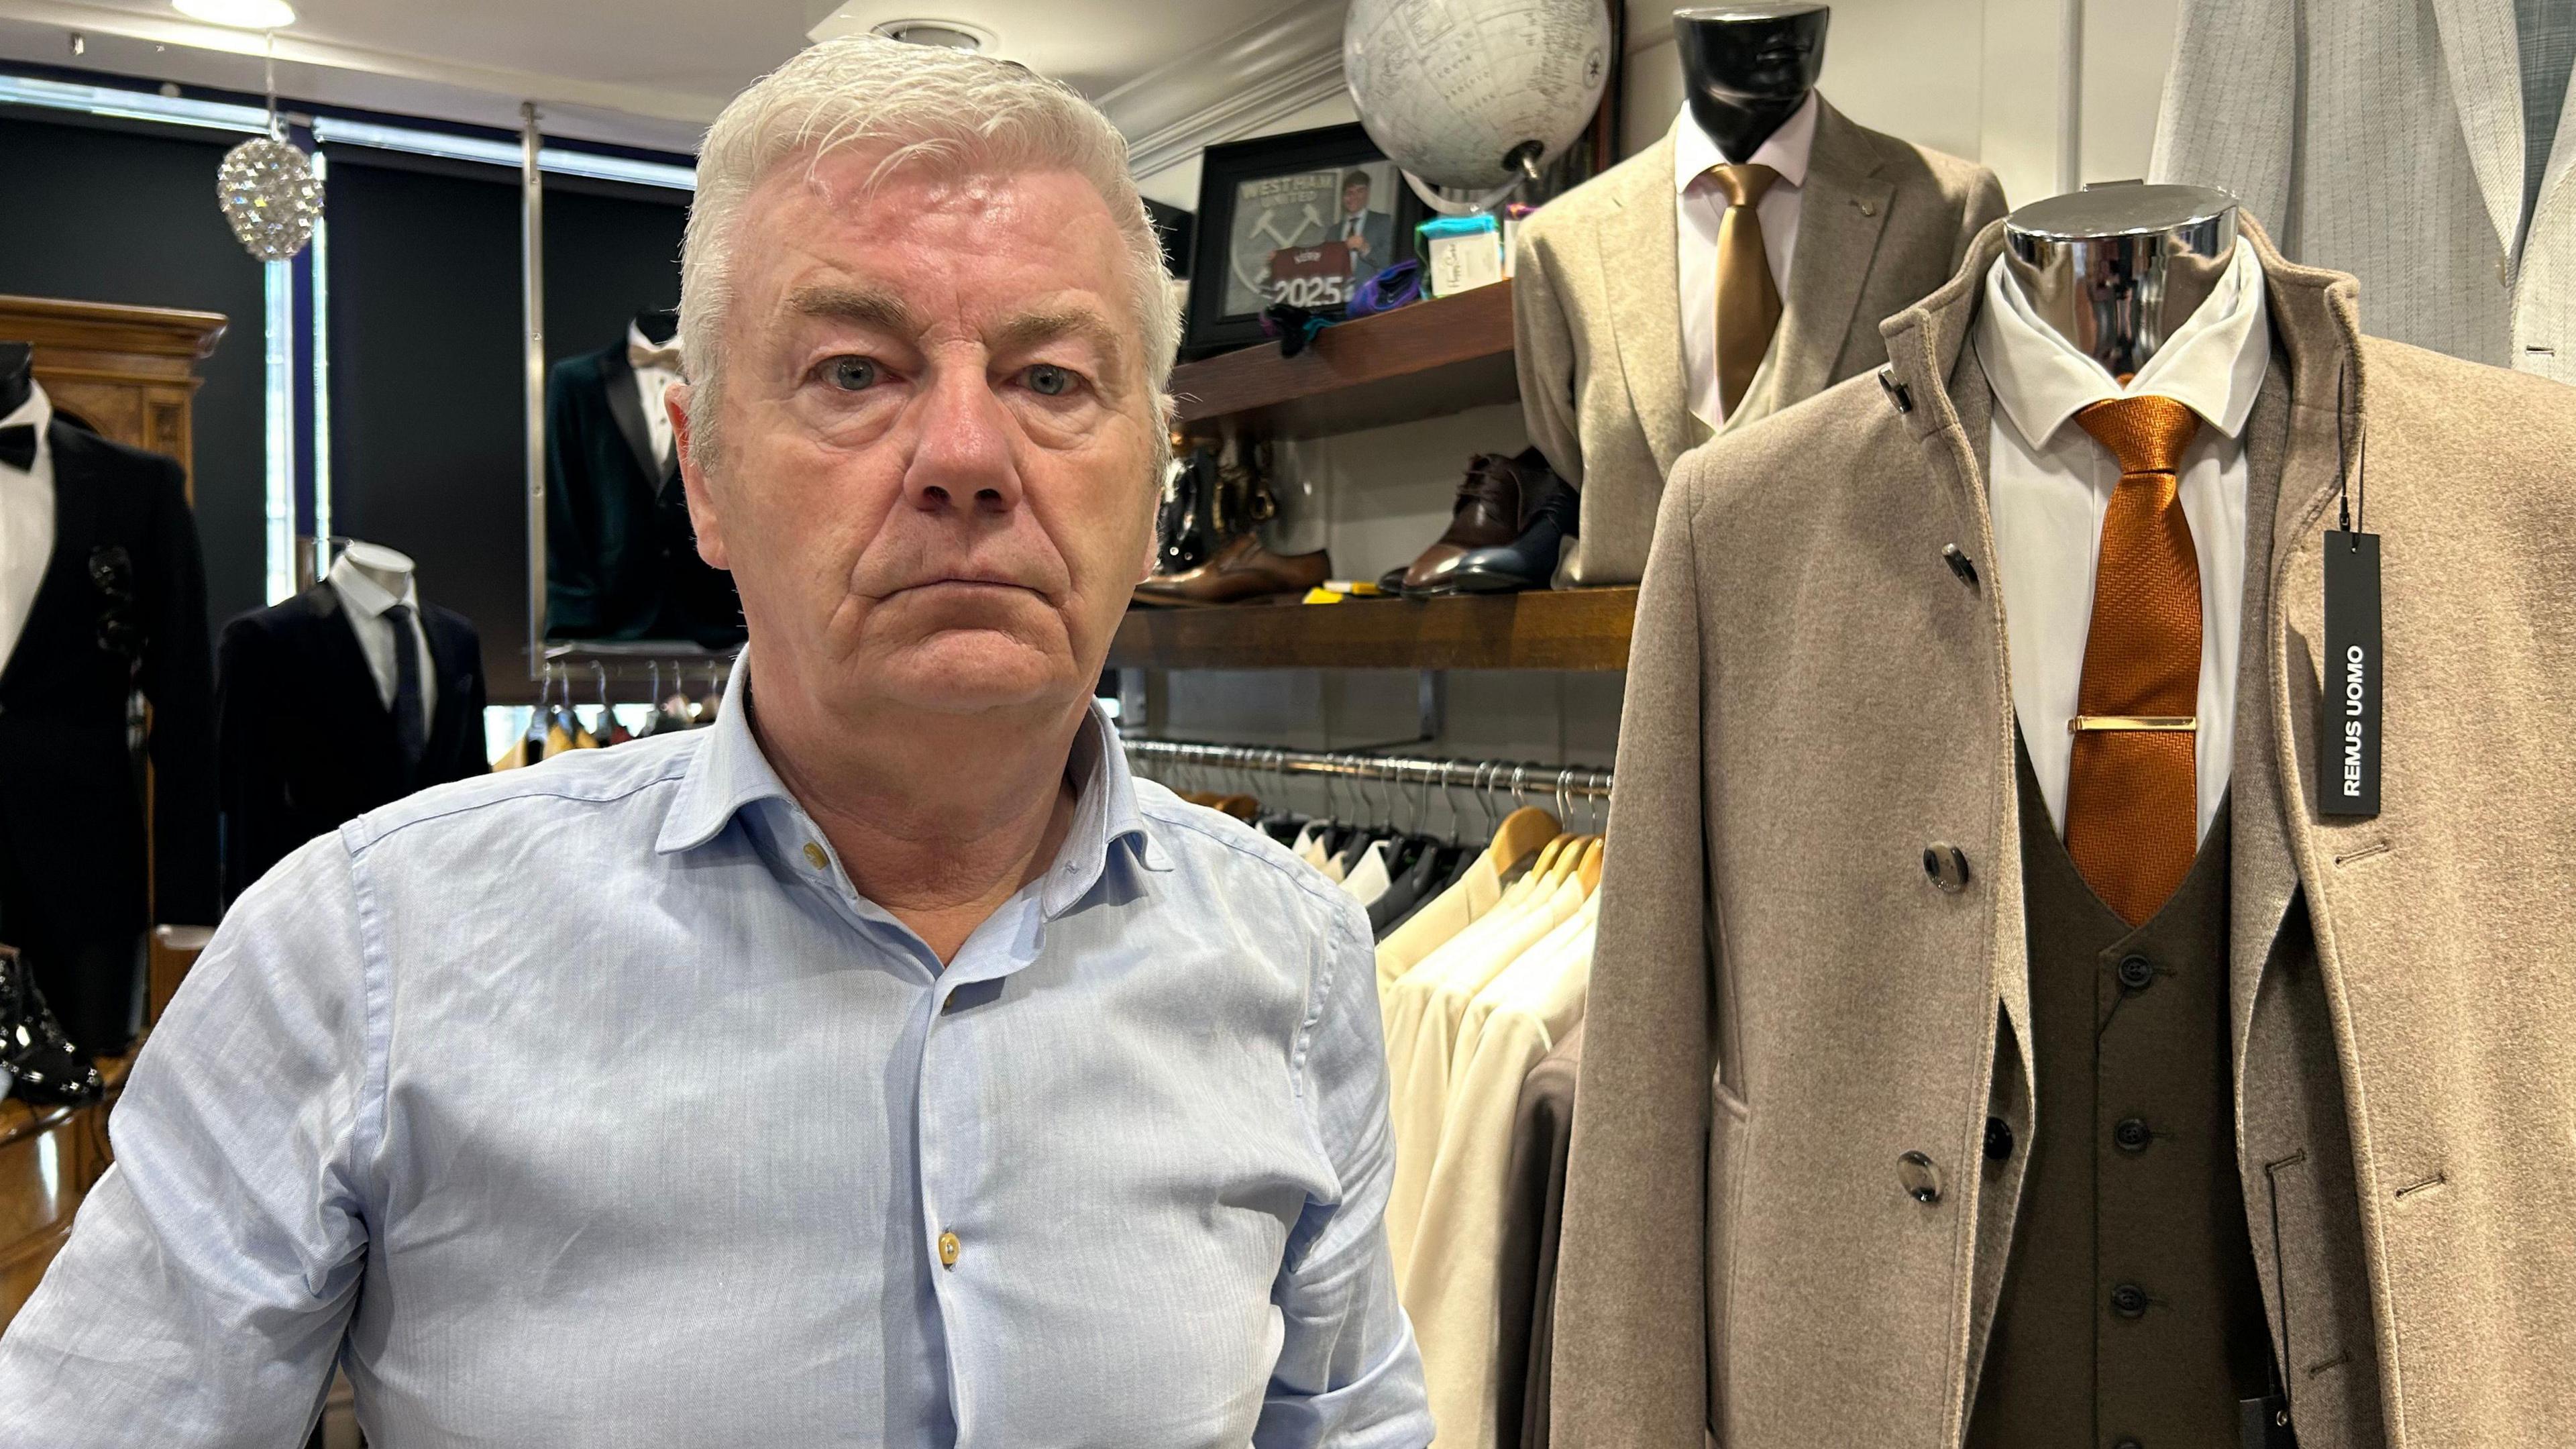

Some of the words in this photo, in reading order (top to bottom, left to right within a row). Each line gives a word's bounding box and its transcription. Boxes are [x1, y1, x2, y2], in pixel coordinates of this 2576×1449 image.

[1275, 276, 1343, 307] 2025
[2347, 645, 2363, 716] UOMO
[2344, 721, 2362, 796] REMUS
